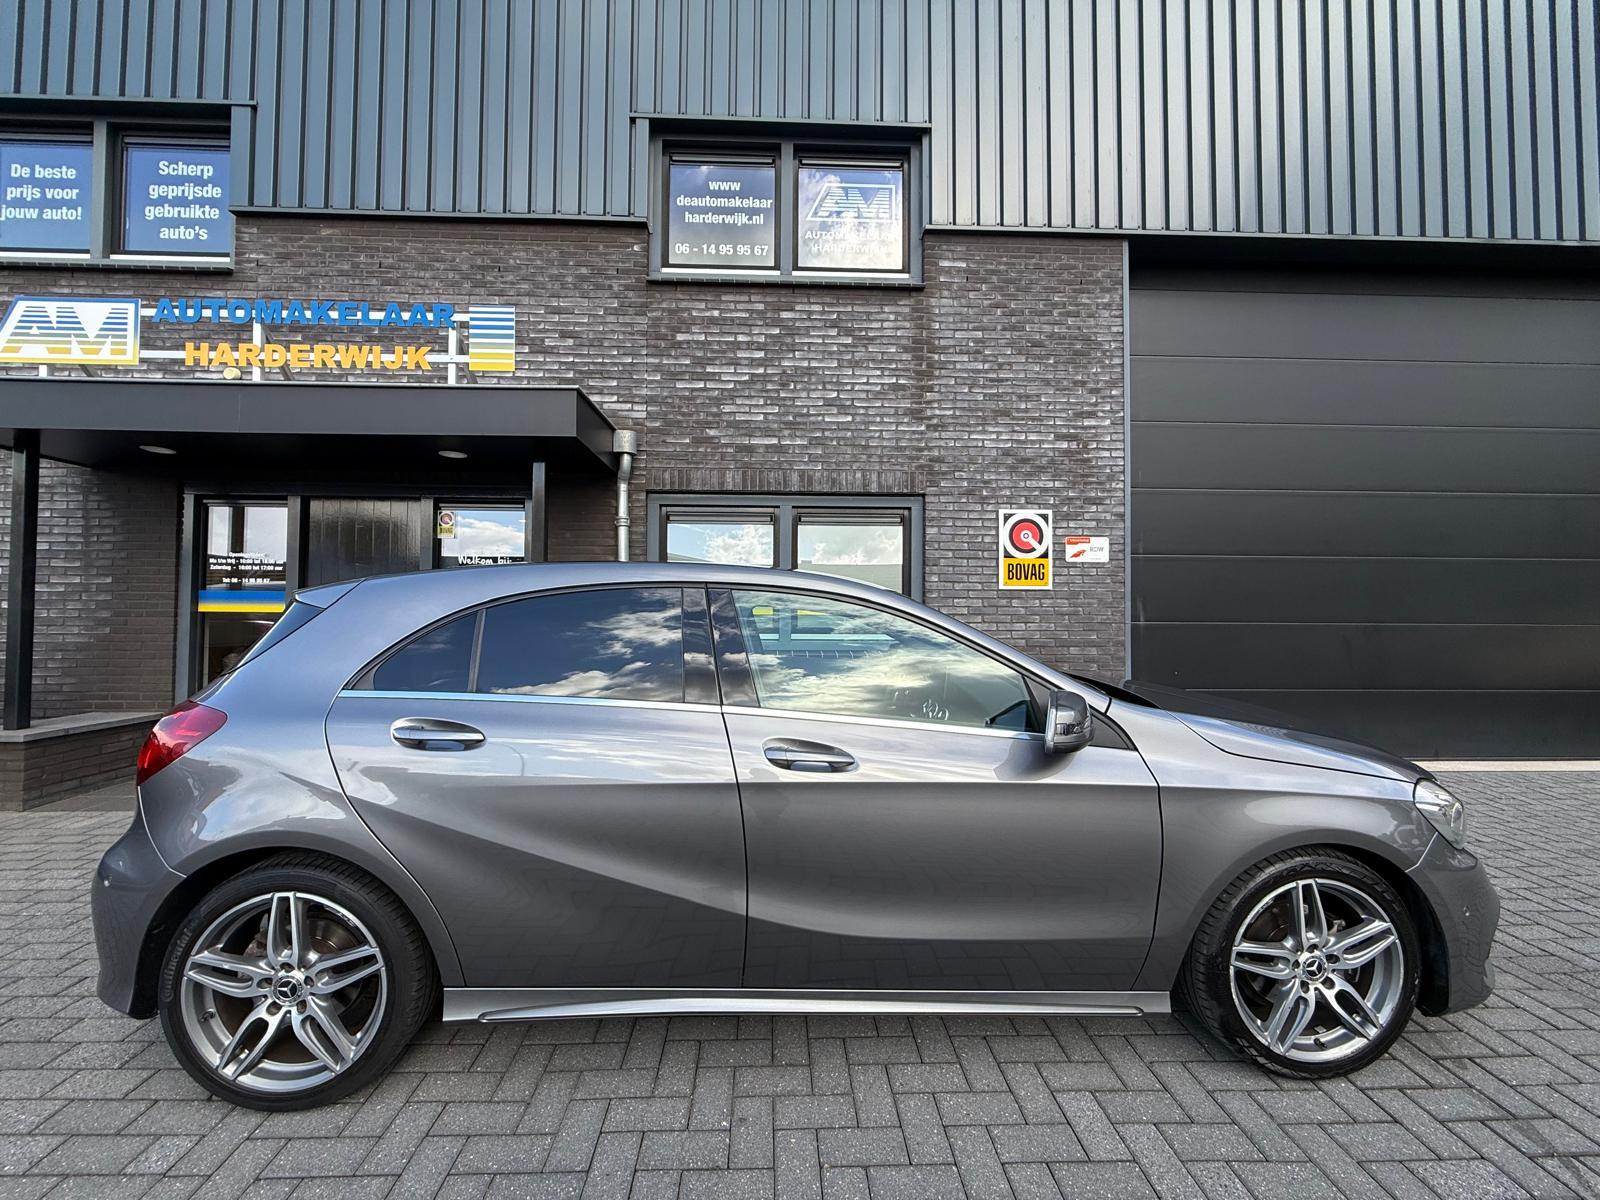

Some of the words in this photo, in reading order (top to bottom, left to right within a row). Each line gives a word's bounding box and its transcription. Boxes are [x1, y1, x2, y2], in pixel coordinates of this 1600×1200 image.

[10, 164, 30, 178] De
[34, 164, 76, 180] beste
[158, 161, 213, 179] Scherp
[6, 185, 40, 201] prijs
[46, 188, 79, 199] voor
[148, 183, 222, 200] geprijsde
[708, 181, 740, 191] www
[676, 195, 772, 208] deautomakelaar
[0, 205, 39, 221] jouw
[42, 207, 82, 220] auto!
[144, 204, 220, 220] gebruikte
[684, 211, 764, 226] harderwijk.nl
[160, 226, 208, 240] auto's
[675, 244, 690, 254] 06
[702, 244, 716, 255] 14
[718, 244, 734, 255] 95
[736, 245, 751, 255] 95
[754, 246, 768, 256] 67
[152, 298, 456, 328] AUTOMAKELAAR
[0, 306, 128, 355] AM
[184, 342, 432, 370] HARDERWIJK
[458, 554, 494, 565] Welkom
[1008, 563, 1045, 580] BOVAG
[161, 928, 192, 1002] Continental
